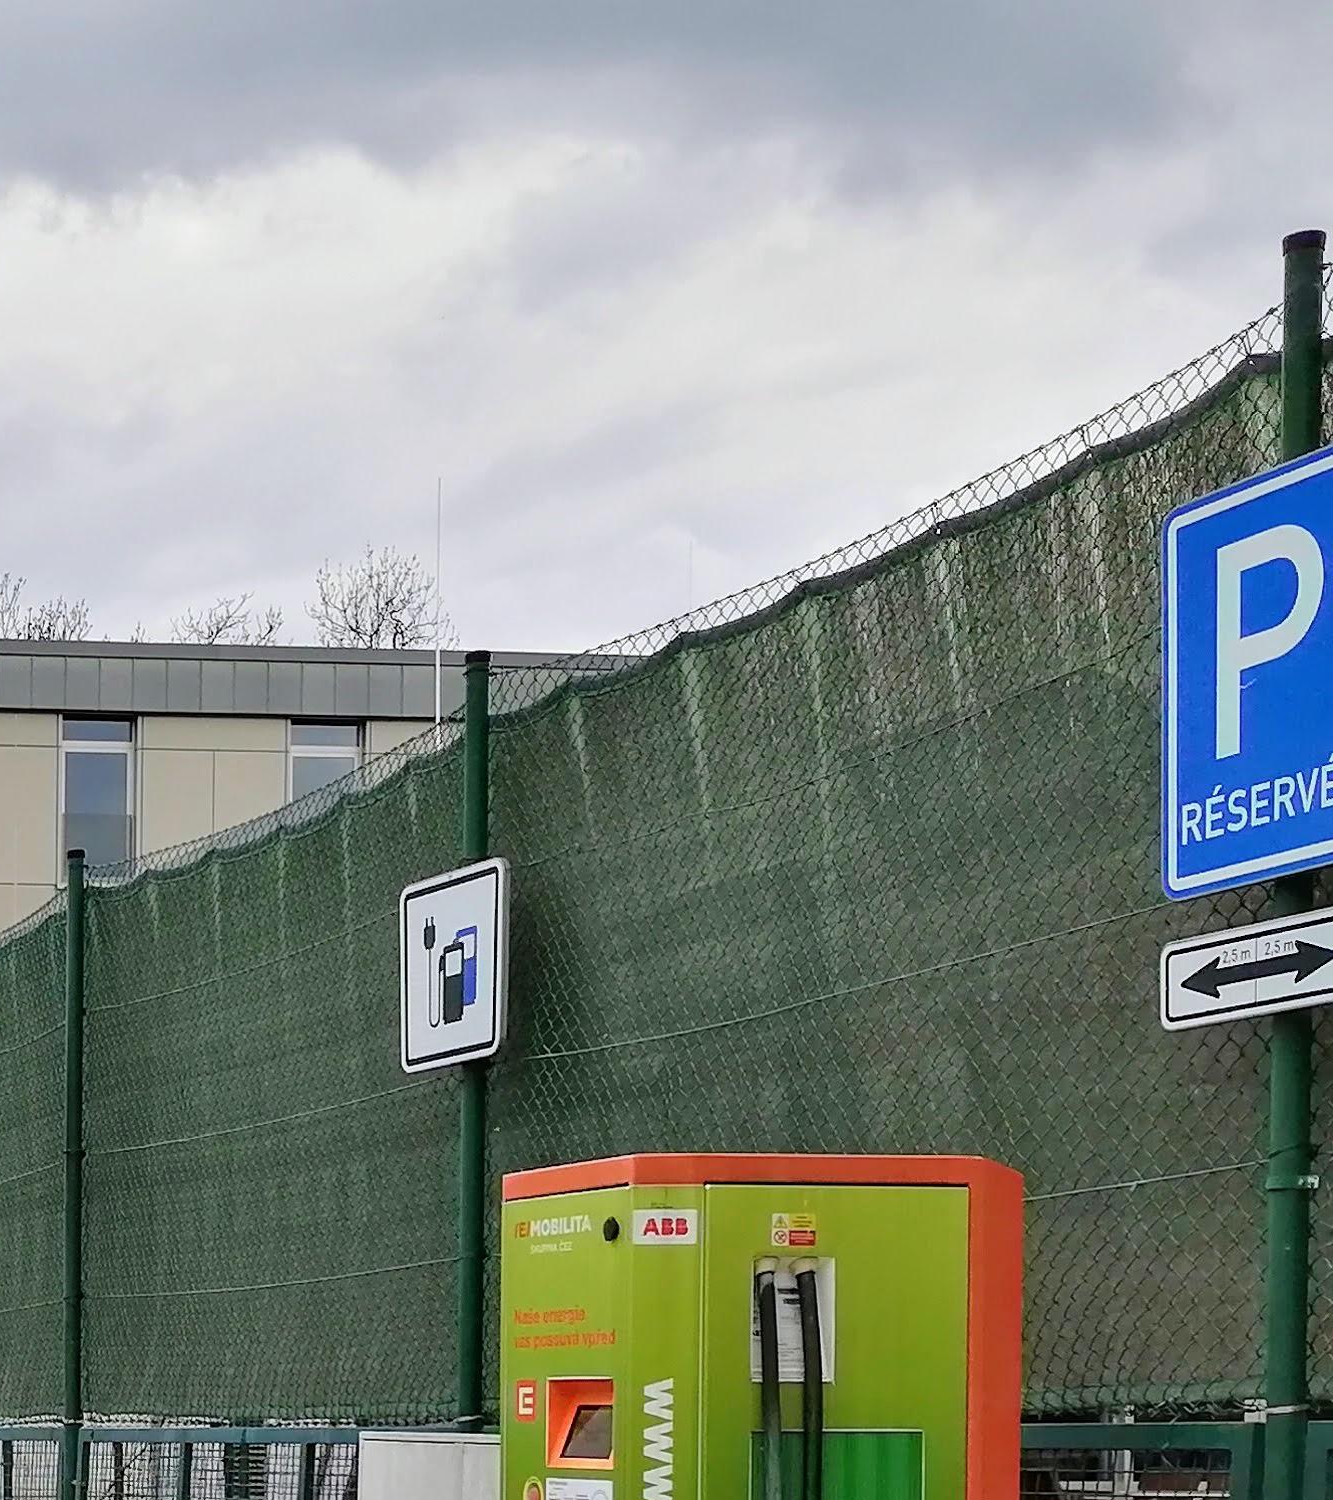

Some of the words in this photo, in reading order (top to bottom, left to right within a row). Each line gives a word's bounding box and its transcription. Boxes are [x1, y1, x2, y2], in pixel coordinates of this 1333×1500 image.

[1215, 523, 1325, 760] P
[1264, 940, 1281, 957] 2,5
[643, 1217, 689, 1237] ABB
